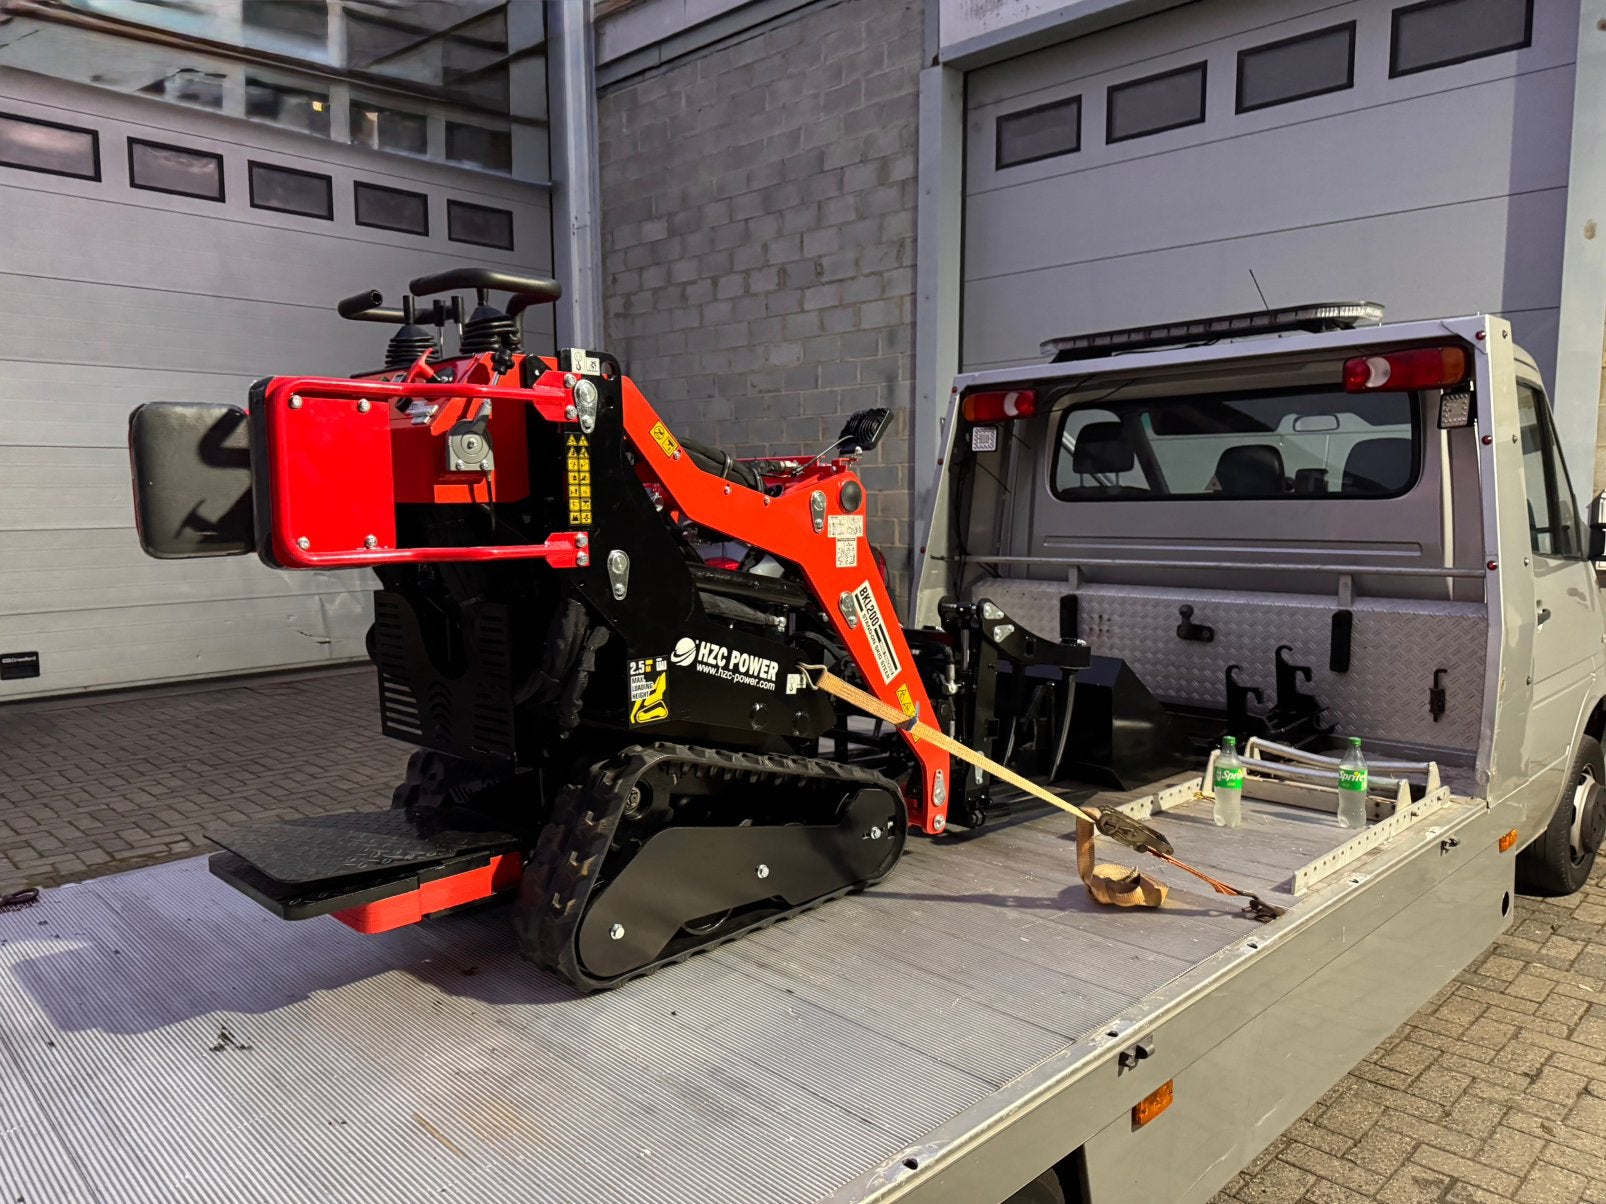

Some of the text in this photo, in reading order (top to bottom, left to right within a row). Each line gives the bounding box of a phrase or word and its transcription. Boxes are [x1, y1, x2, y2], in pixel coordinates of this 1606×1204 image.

[859, 586, 879, 627] BKL200
[630, 660, 645, 675] 2.5
[696, 663, 776, 691] www.hzc-power.com
[697, 641, 728, 667] HZC
[729, 650, 779, 681] POWER
